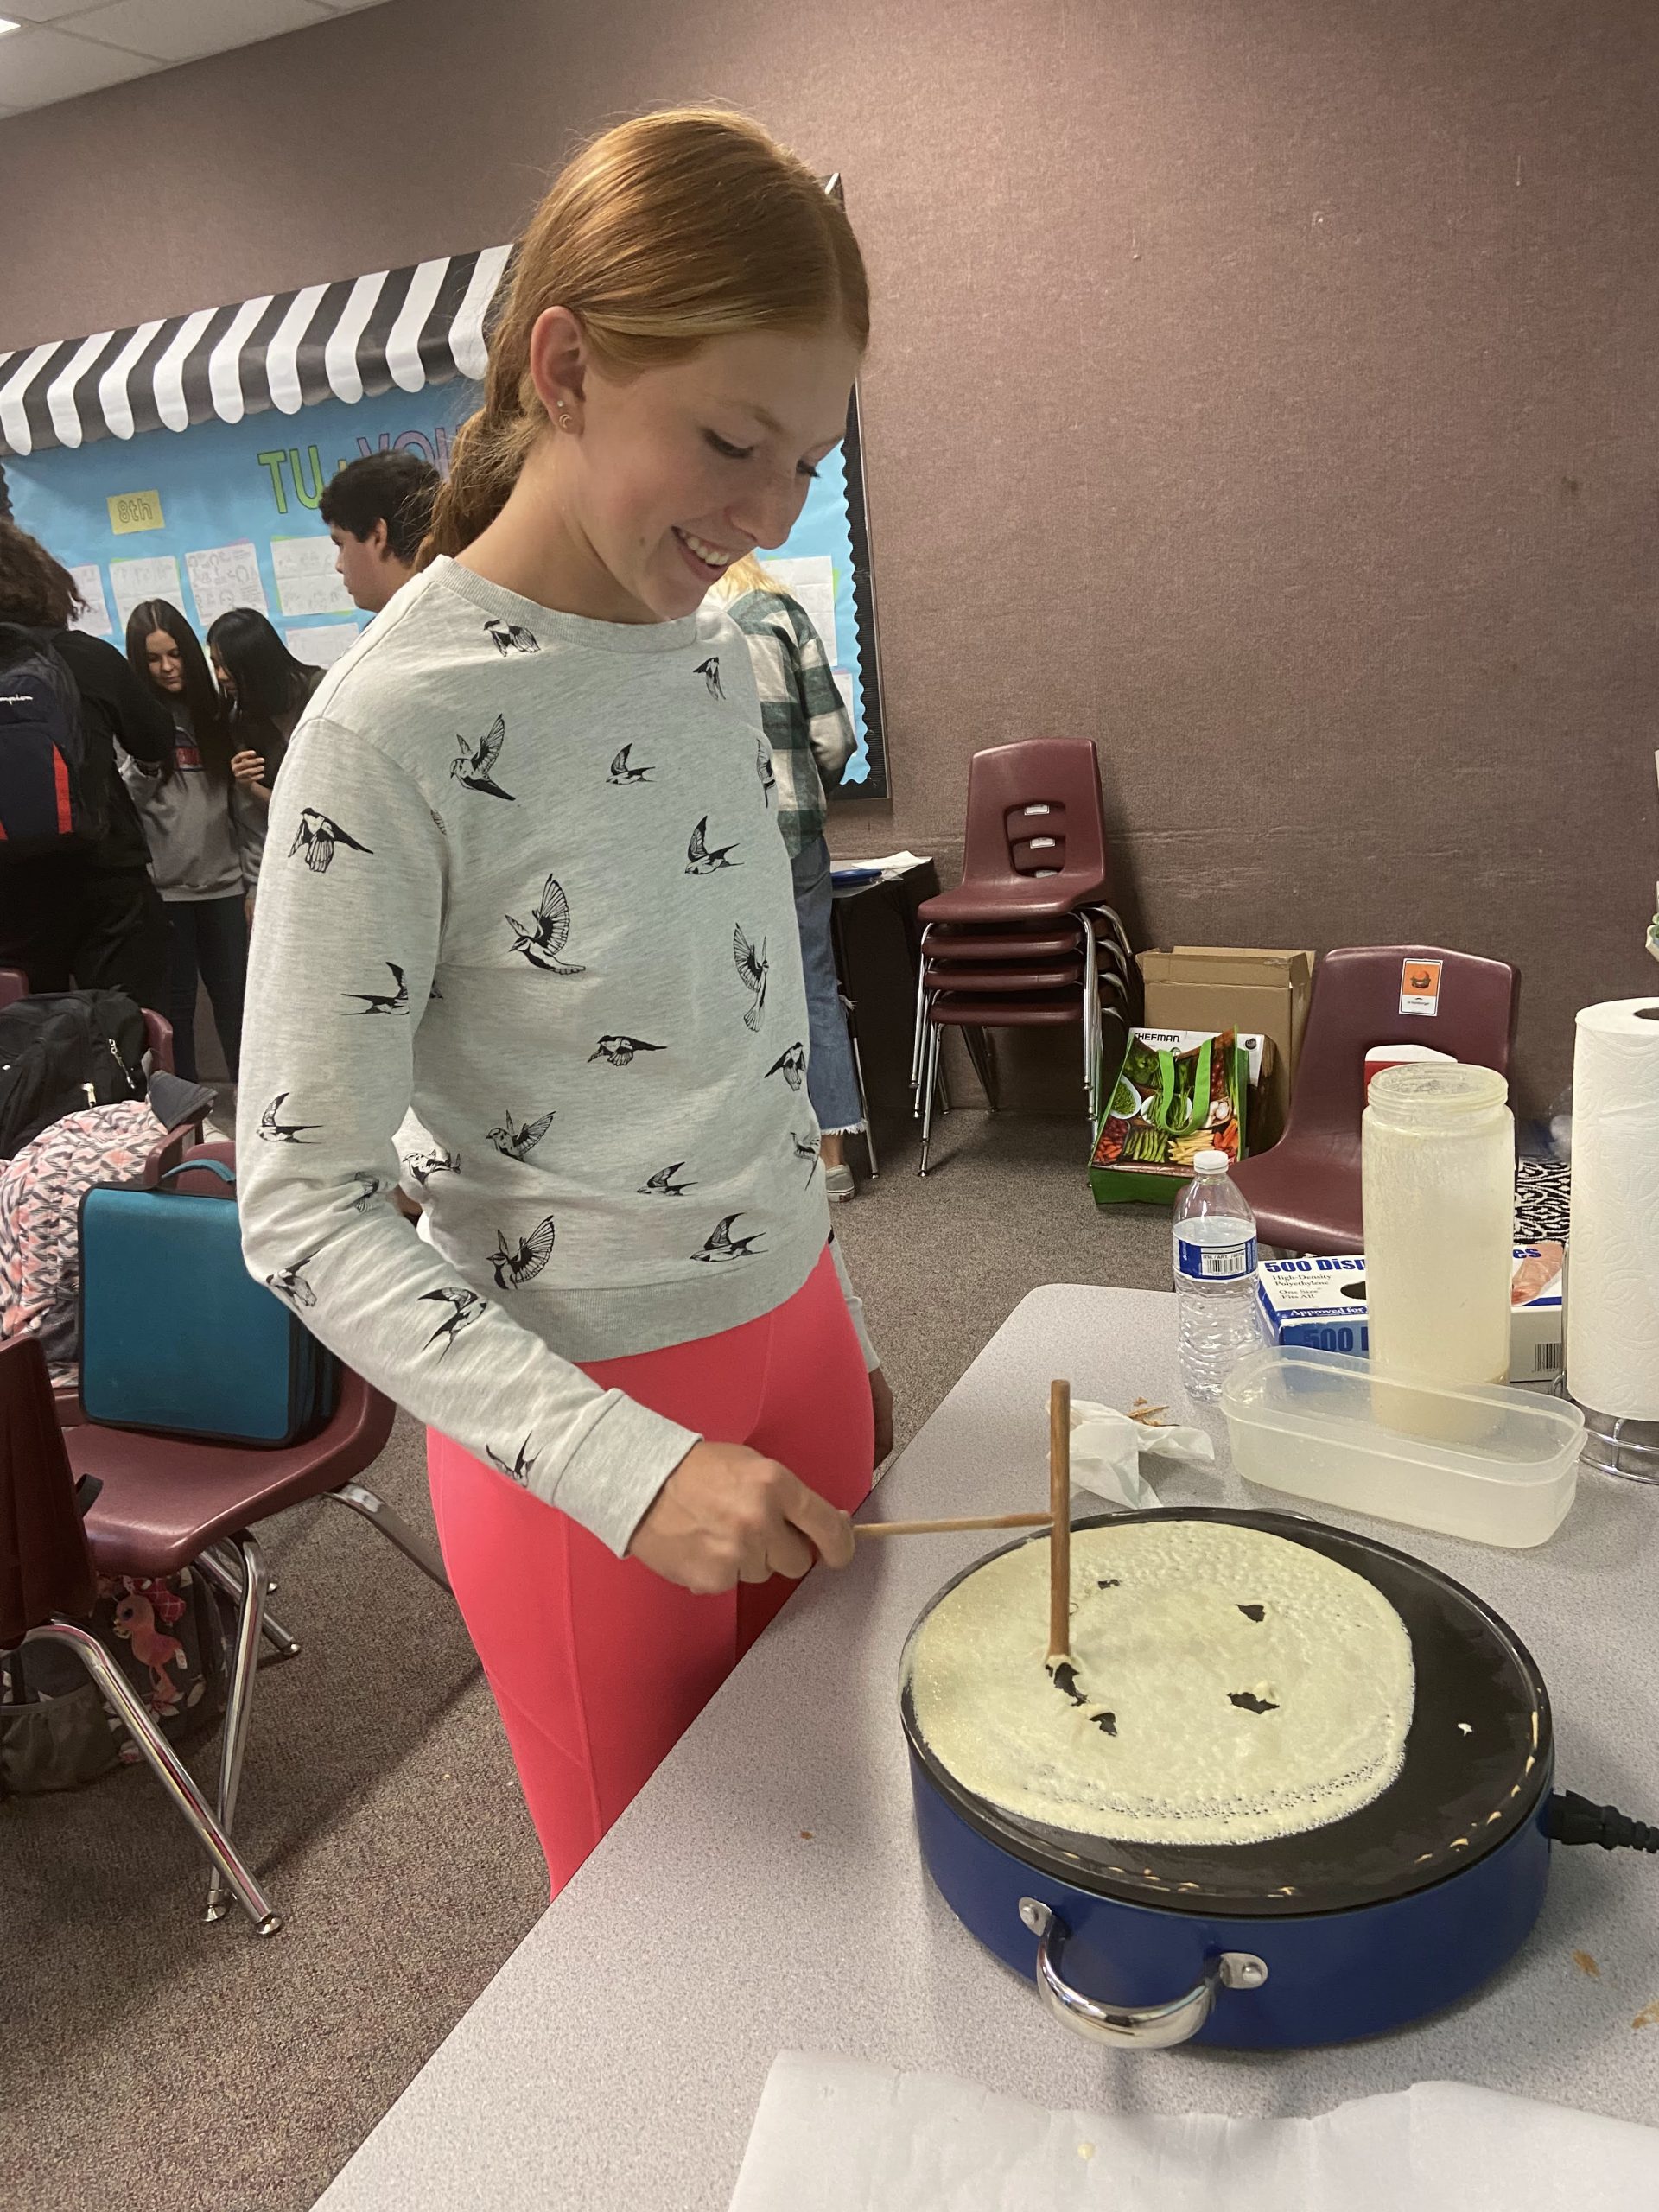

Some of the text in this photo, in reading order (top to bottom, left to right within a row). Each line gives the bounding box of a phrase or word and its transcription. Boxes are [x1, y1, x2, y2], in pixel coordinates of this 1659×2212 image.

[257, 445, 325, 514] TU
[117, 498, 153, 524] 8th
[1264, 1260, 1312, 1272] 500
[1291, 1307, 1344, 1316] Approved
[1303, 1327, 1353, 1351] 500
